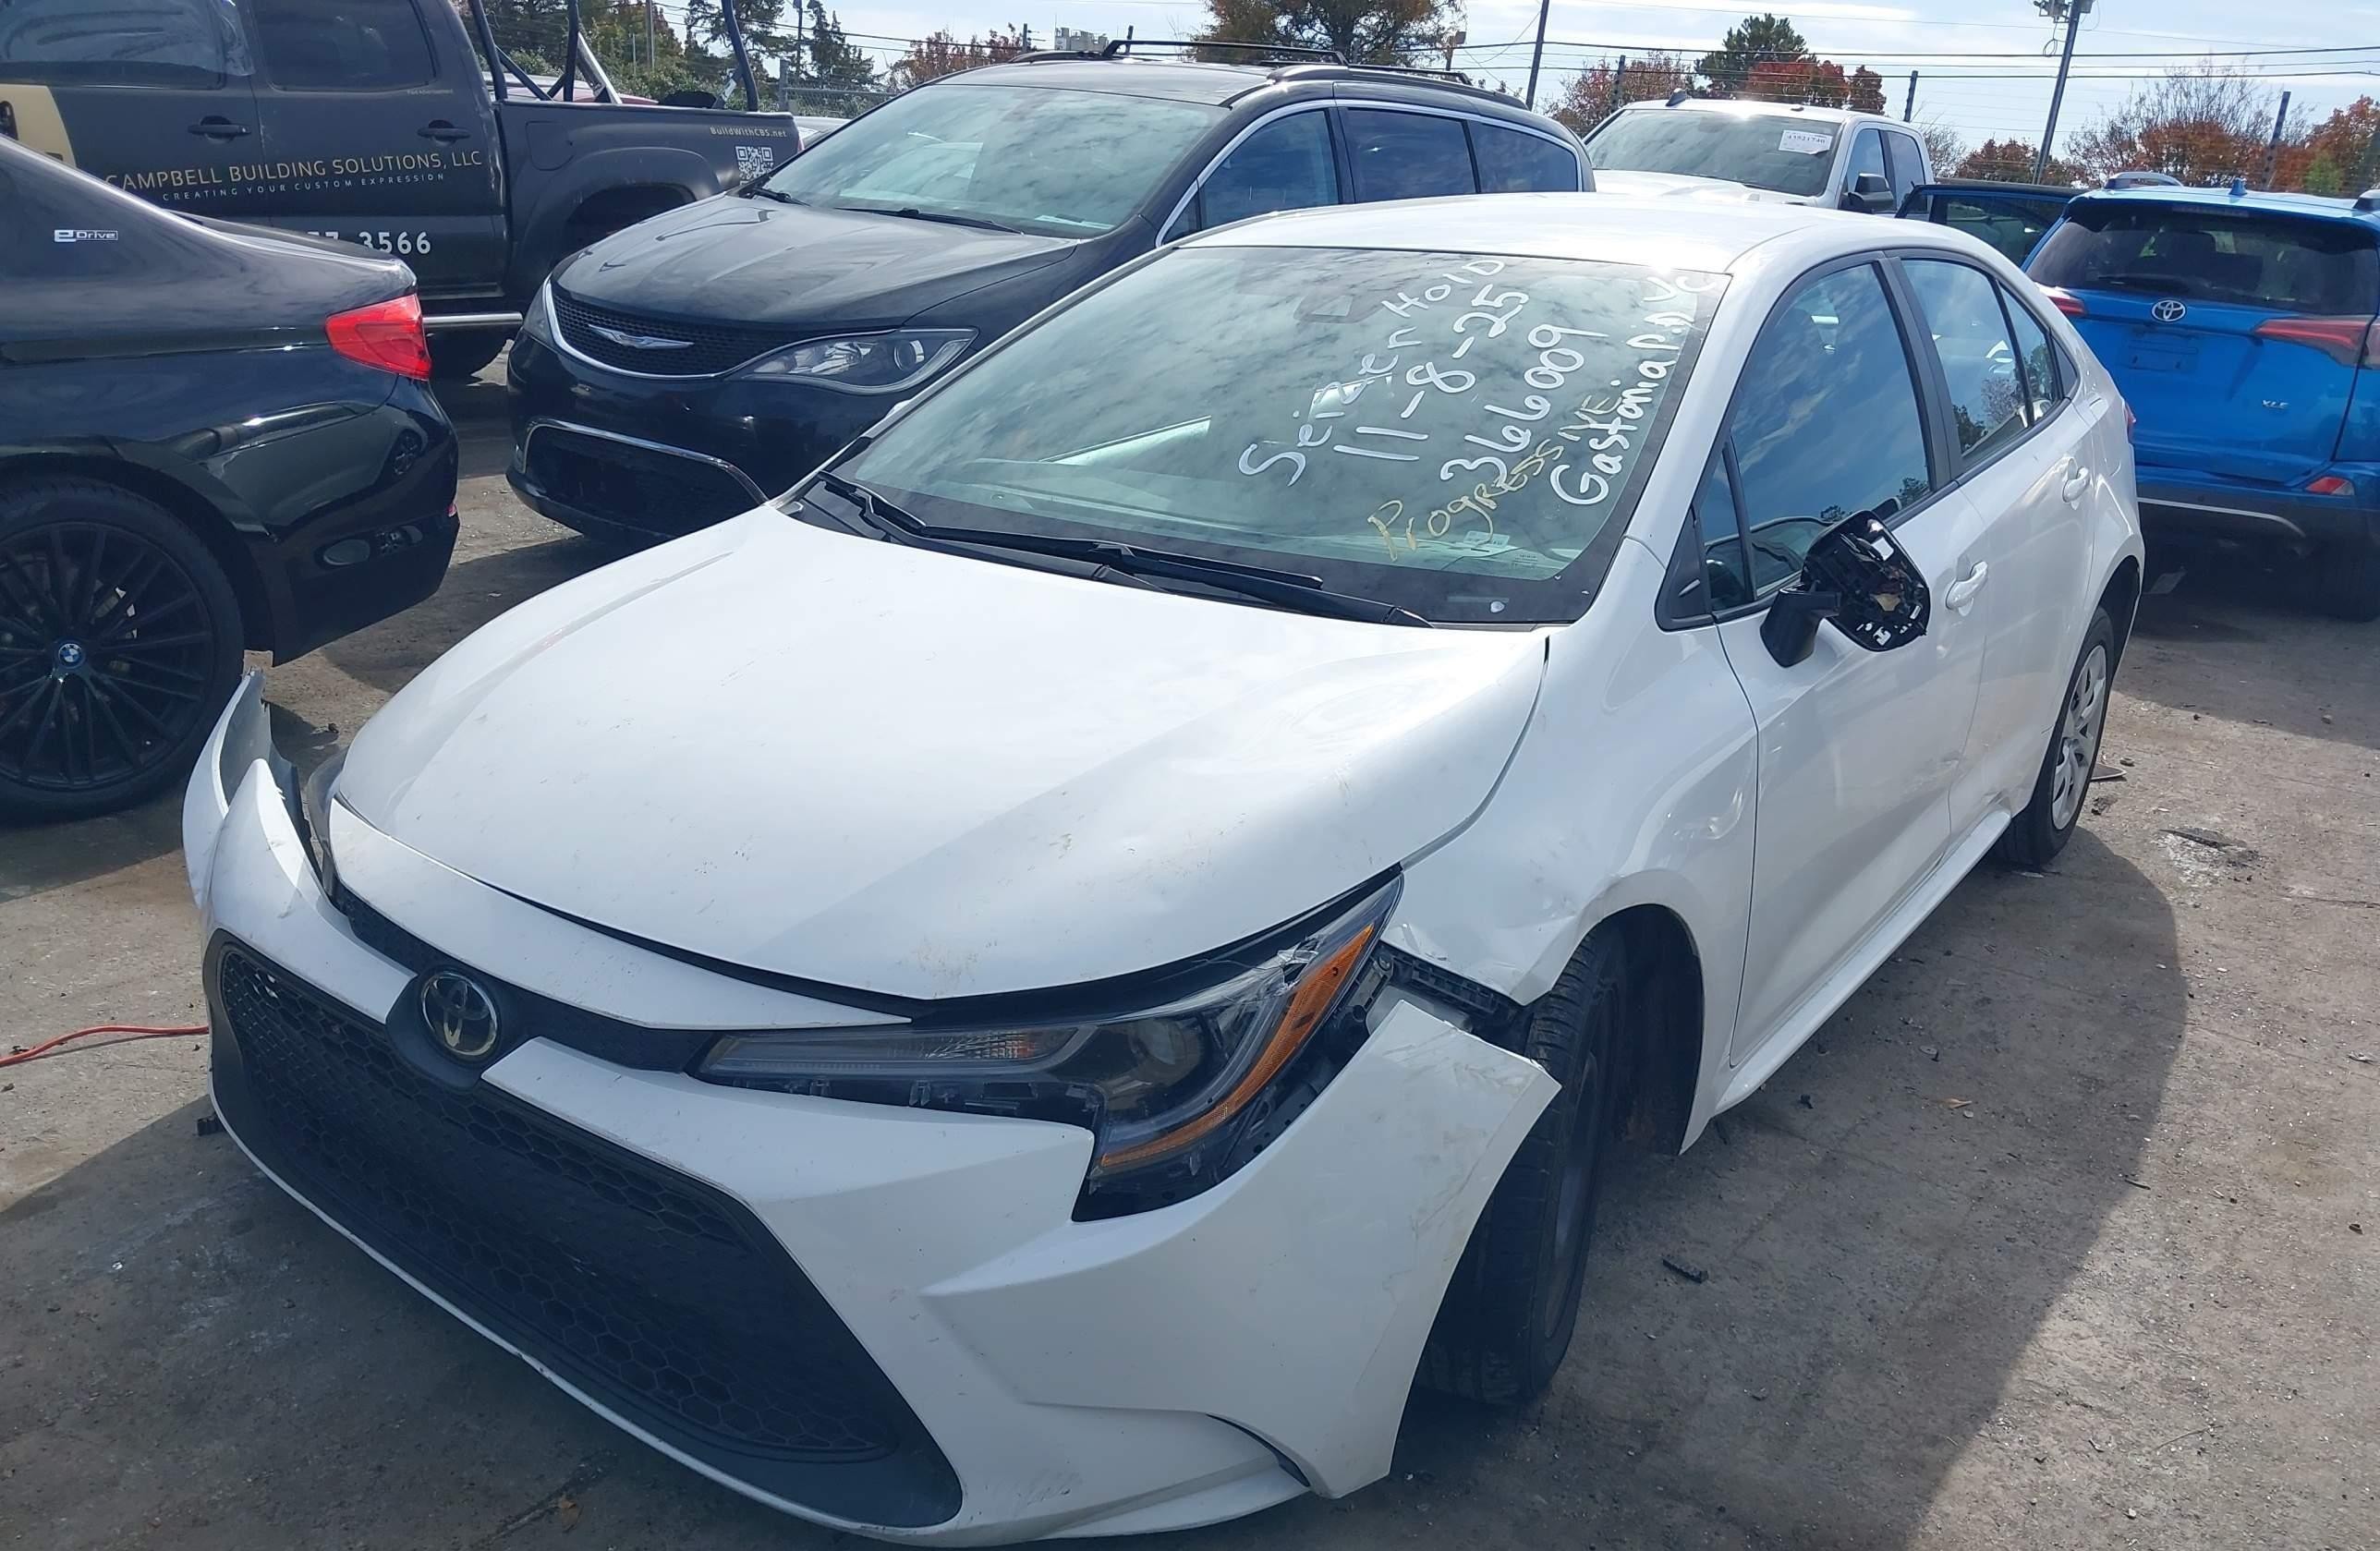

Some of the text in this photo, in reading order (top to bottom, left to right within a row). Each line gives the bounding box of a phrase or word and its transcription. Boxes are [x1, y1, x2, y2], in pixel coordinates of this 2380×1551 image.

[228, 161, 326, 182] BUILDING
[333, 152, 447, 175] SOLUTIONS,
[451, 151, 482, 167] LLC
[710, 126, 787, 138] BuildWithCBS.net
[163, 173, 443, 201] CREATING YOUR CUSTOM EXPRESSION
[1333, 284, 1530, 461] 11-8-25
[1439, 323, 1609, 488] 366009
[1549, 359, 1677, 505] Gastonia
